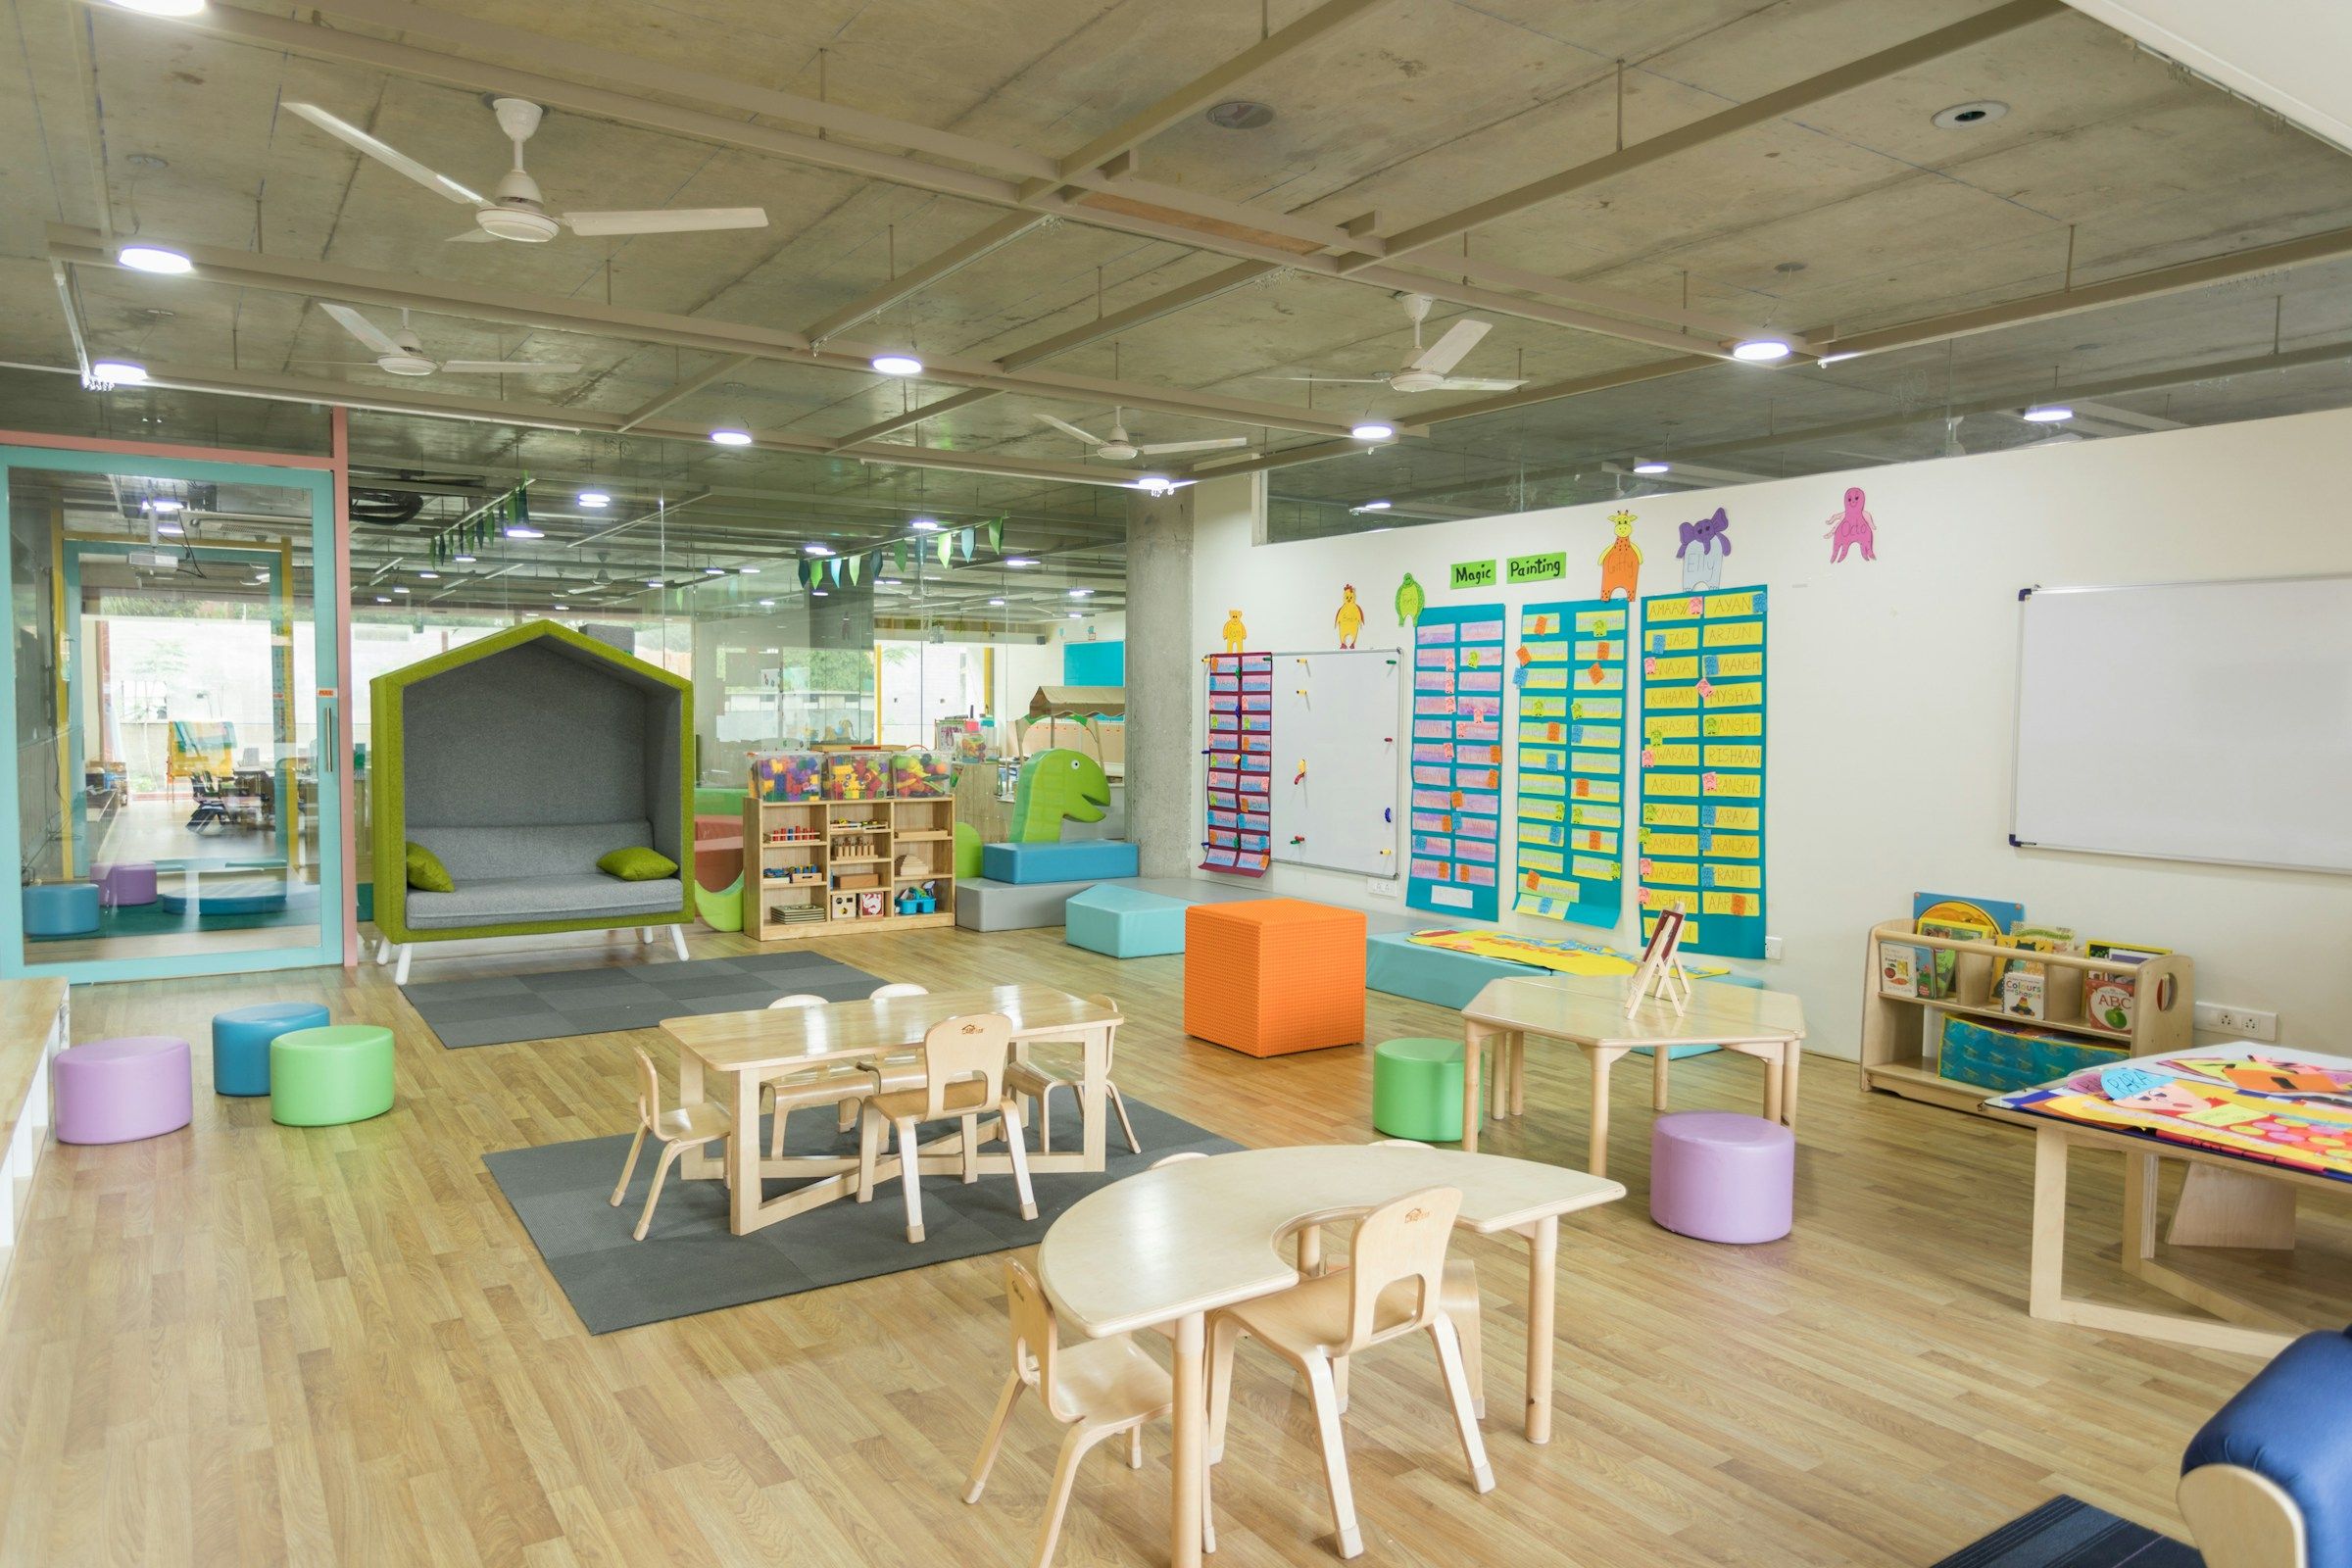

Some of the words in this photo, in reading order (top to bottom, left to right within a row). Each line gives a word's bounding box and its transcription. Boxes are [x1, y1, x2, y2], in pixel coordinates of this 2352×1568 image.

[1456, 564, 1491, 584] Magic
[1510, 558, 1560, 577] Painting
[1688, 553, 1715, 581] Elly
[1708, 626, 1752, 643] ARJUN
[1651, 778, 1692, 792] ARJUN
[2006, 980, 2041, 993] Colours
[2014, 989, 2041, 1000] Shapes
[2098, 994, 2132, 1009] ABC
